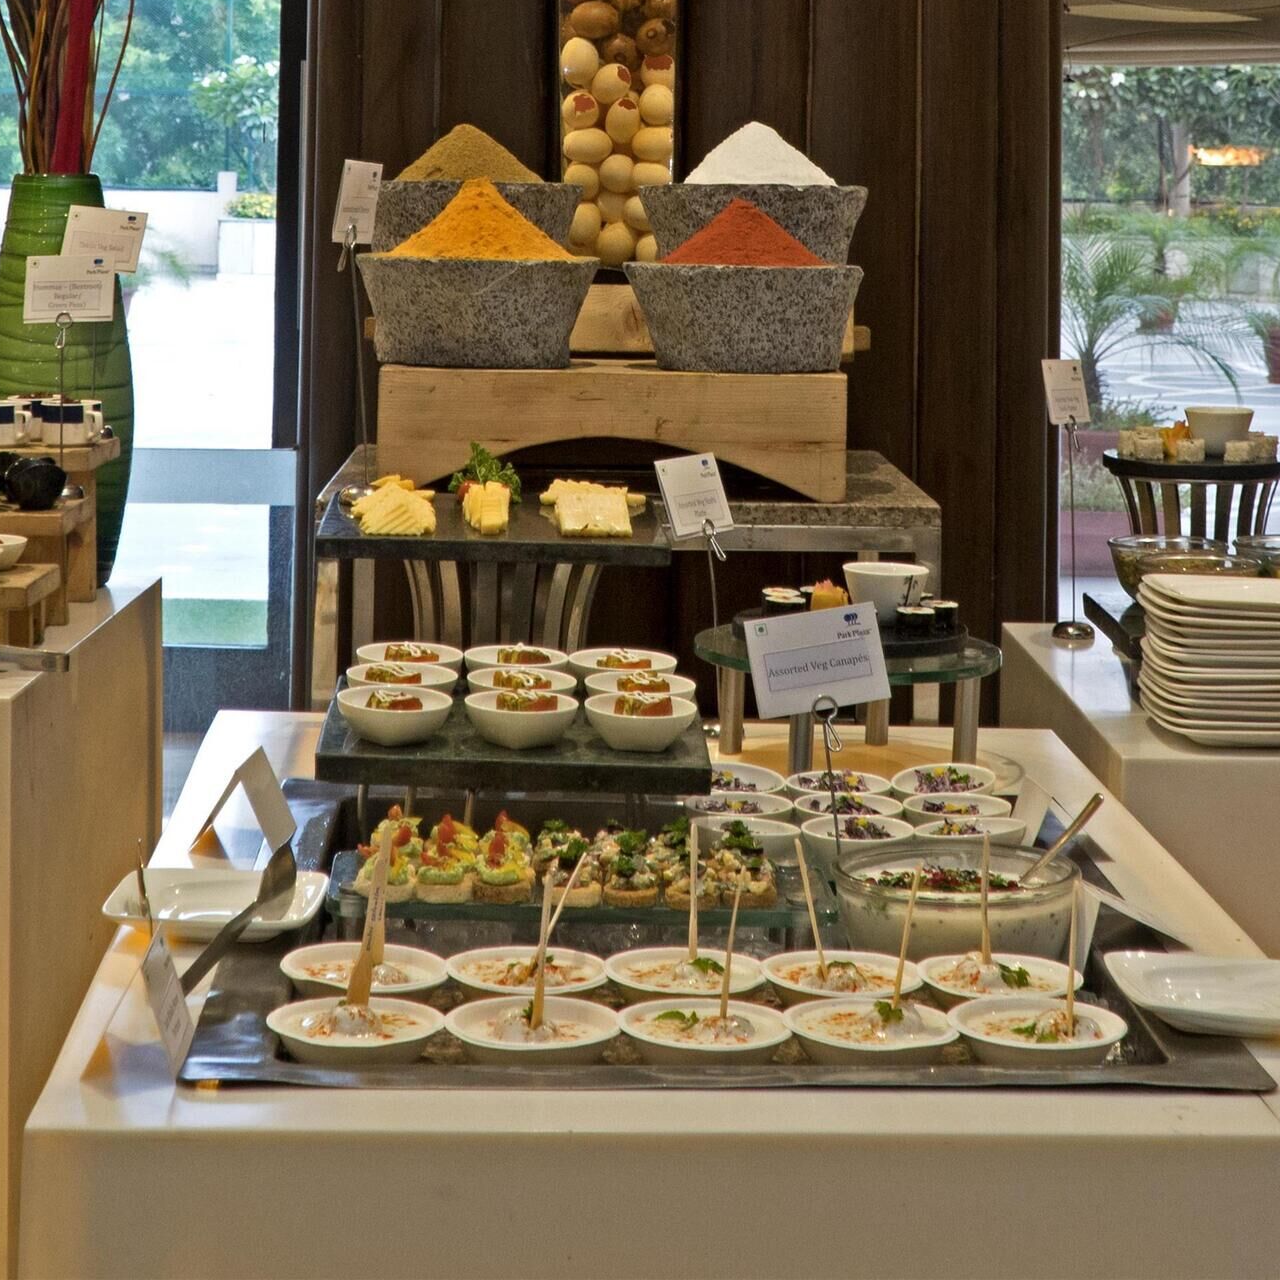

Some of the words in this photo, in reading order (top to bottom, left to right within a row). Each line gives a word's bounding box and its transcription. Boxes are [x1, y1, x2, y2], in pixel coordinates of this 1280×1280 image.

[837, 631, 853, 640] Park
[768, 660, 810, 679] Assorted
[810, 659, 828, 671] Veg
